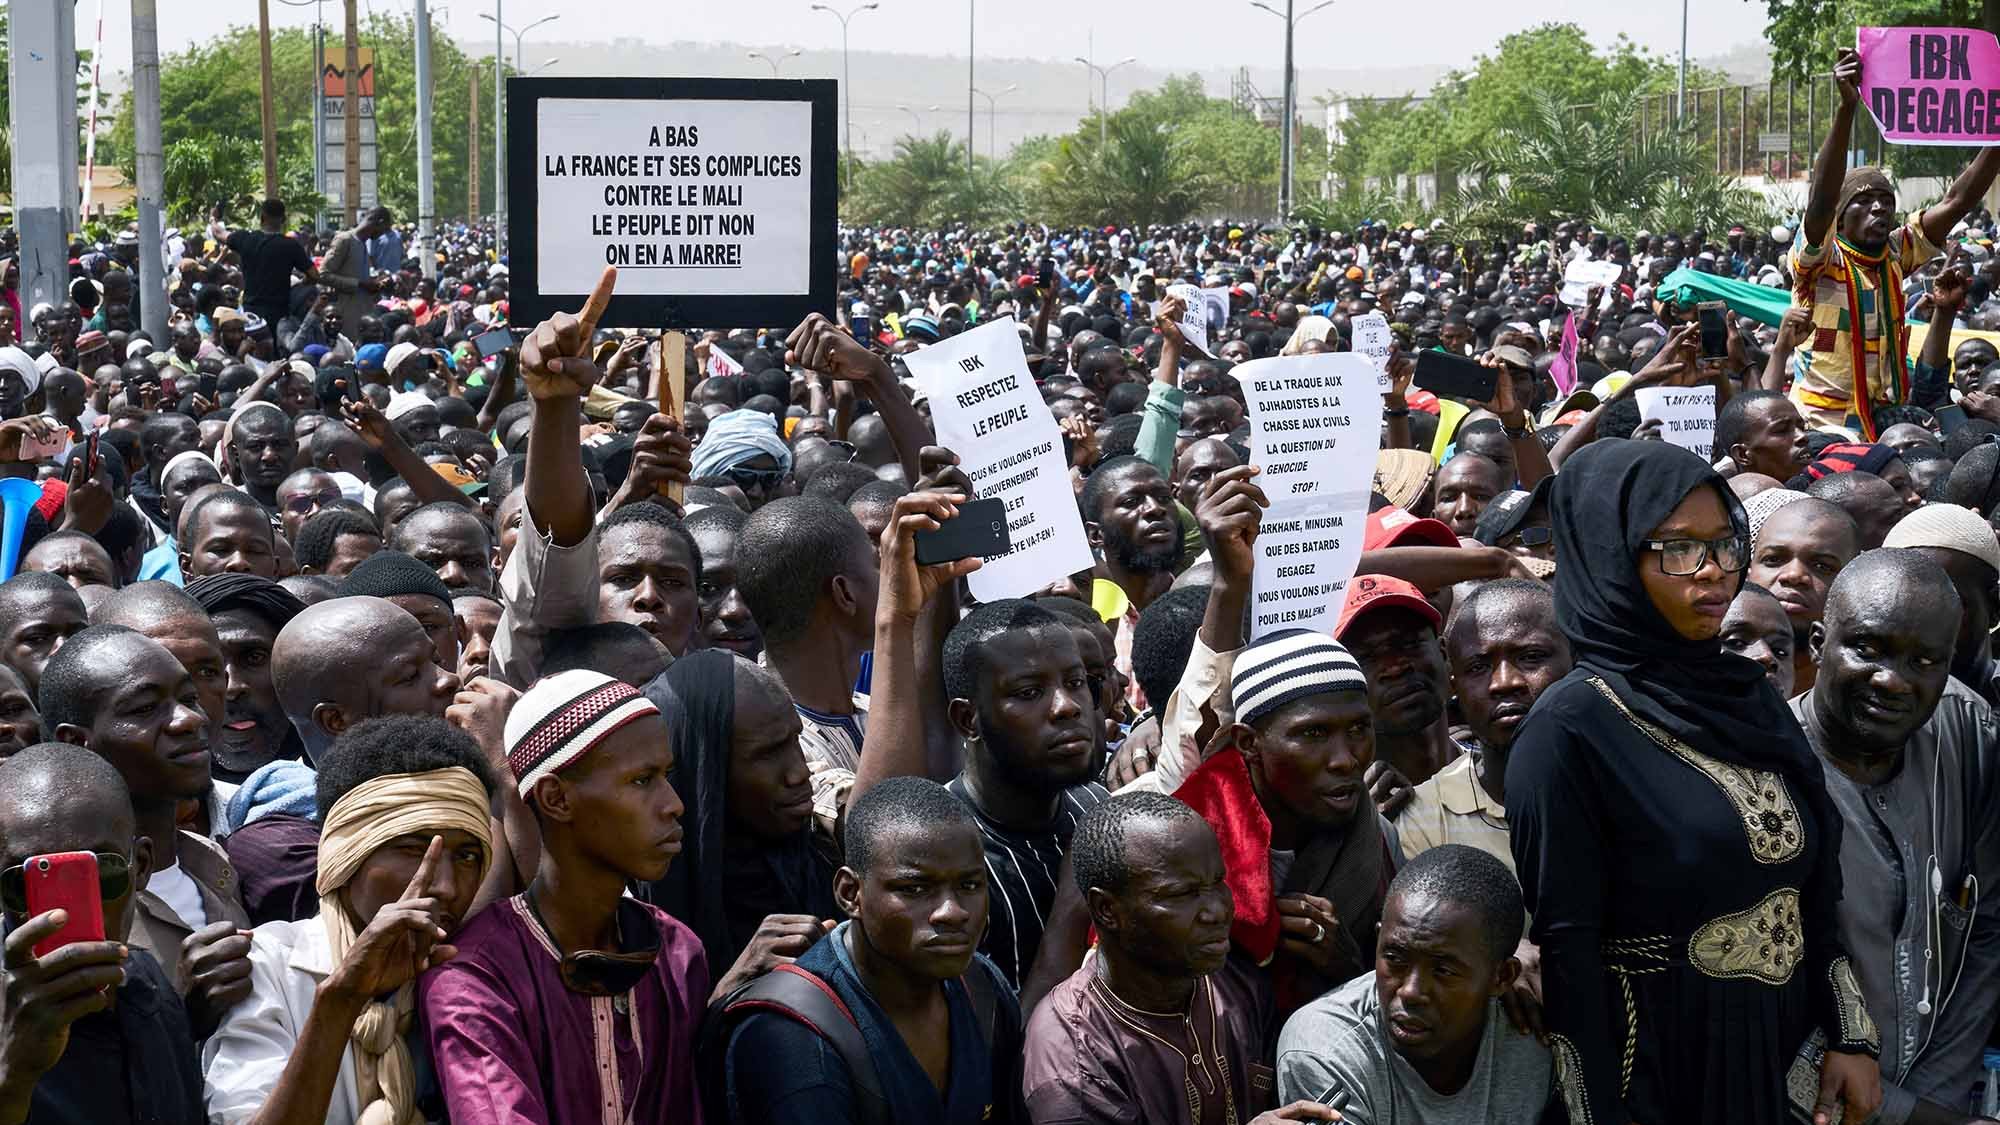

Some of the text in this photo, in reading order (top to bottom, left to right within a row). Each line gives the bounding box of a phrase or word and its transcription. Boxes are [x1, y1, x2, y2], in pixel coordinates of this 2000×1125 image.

[1909, 34, 1971, 80] IBK
[1871, 86, 2000, 135] DEGAGE
[649, 126, 699, 147] A BAS
[545, 155, 802, 177] LA FRANCE ET SES COMPLICES
[604, 185, 743, 206] CONTRE LE MALI
[592, 214, 755, 236] LE PEUPLE DIT NON
[606, 244, 742, 265] ON EN A MARRE!
[1365, 332, 1378, 344] TUE
[958, 355, 984, 373] IBK
[956, 375, 1019, 409] RESPECTEZ
[1254, 376, 1342, 392] DE LA TRAQUE AUX
[1259, 396, 1341, 412] DJIHADISTES A LA
[973, 404, 1028, 437] LE PEUPLE
[1263, 415, 1351, 432] CHASSE AUX CIVILS
[1266, 438, 1336, 455] LA QUESTION DU
[988, 463, 998, 475] NE
[998, 449, 1032, 471] VOULONS
[1033, 441, 1053, 457] PLUS
[1267, 461, 1308, 475] GENOCIDE
[982, 467, 1039, 498] GOUVERNEMENT
[1291, 482, 1313, 493] STOP
[1005, 496, 1025, 512] LE ET
[1009, 512, 1035, 532] NSABLE
[1260, 517, 1343, 535] ARKHANE, MINUSMA
[1026, 528, 1050, 548] VA-T-EN
[1265, 538, 1340, 557] QUE DES BATARDS
[1277, 564, 1315, 578] DEGAGEZ
[1258, 590, 1279, 603] NOUS
[1281, 585, 1319, 600] VOULONS
[1321, 583, 1332, 595] UN
[1258, 613, 1279, 626] POUR
[1281, 611, 1296, 622] LES
